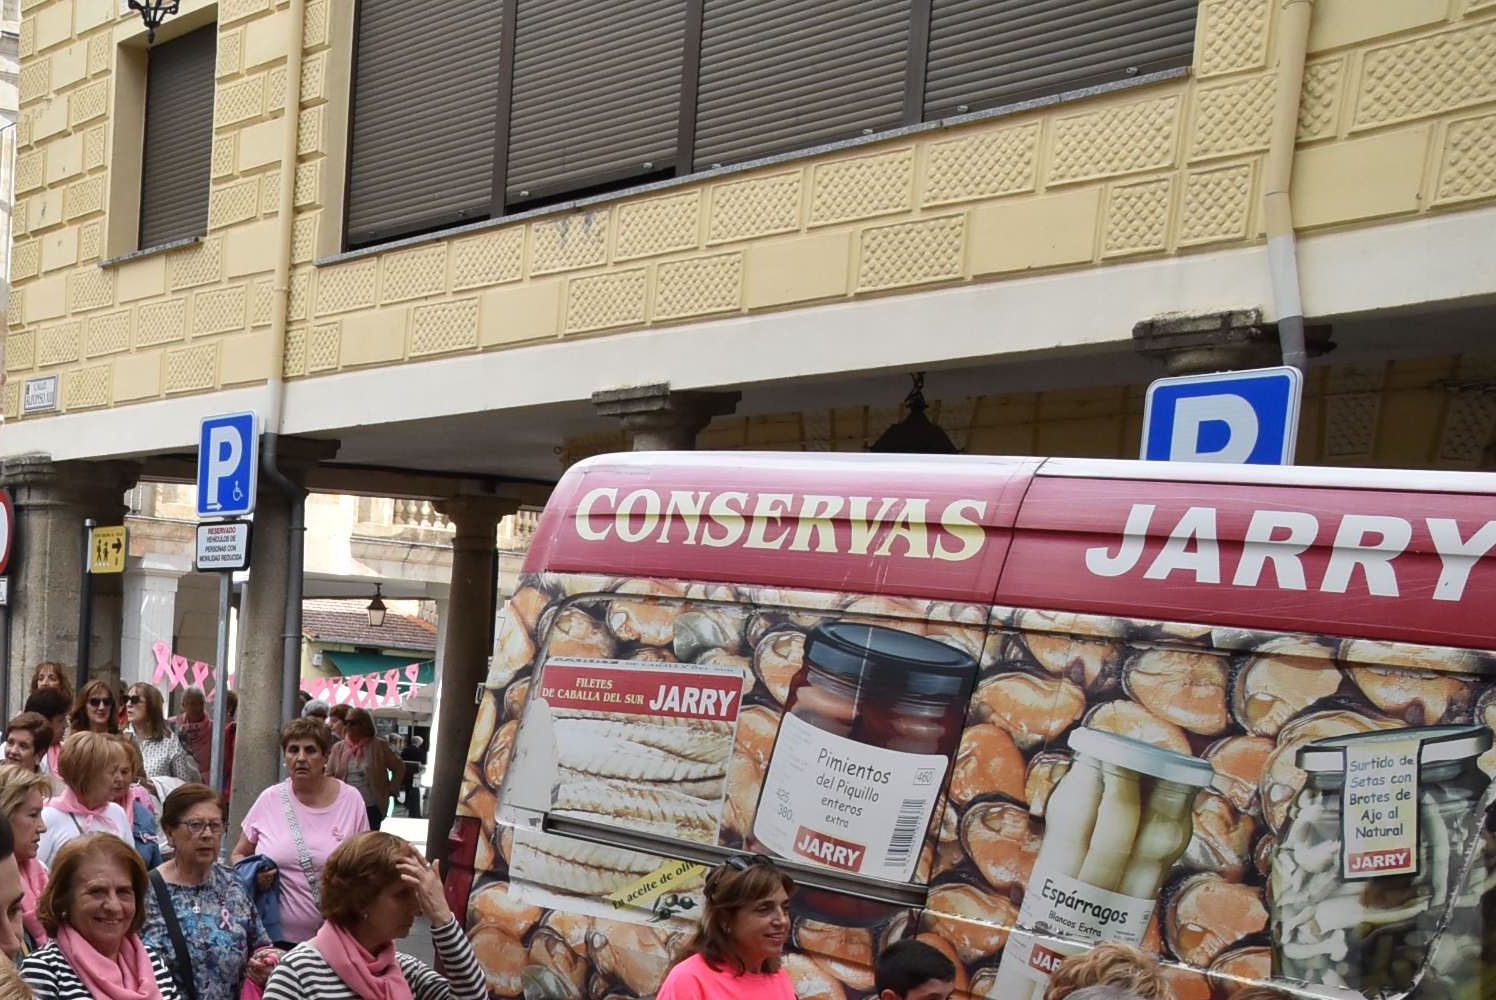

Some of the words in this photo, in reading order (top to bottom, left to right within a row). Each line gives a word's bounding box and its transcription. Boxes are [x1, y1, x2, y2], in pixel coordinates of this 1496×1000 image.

[1170, 393, 1259, 464] P
[207, 425, 242, 504] P
[575, 487, 987, 562] CONSERVAS
[1085, 503, 1496, 602] JARRY
[542, 687, 554, 698] DE
[557, 688, 600, 702] CABALLA
[603, 692, 622, 704] DEL
[625, 694, 644, 705] SUR
[575, 677, 613, 690] FILETES
[649, 684, 737, 717] JARRY
[817, 748, 891, 785] Pimientos
[1350, 755, 1393, 772] Surtido
[1399, 755, 1415, 766] de
[816, 773, 834, 788] del
[837, 779, 880, 803] Piquillo
[1350, 774, 1385, 788] Setas
[1390, 773, 1412, 784] con
[821, 795, 863, 817] enteros
[1349, 791, 1390, 806] Brotes
[1395, 788, 1411, 801] de
[825, 813, 849, 828] extra
[1361, 808, 1382, 824] Ajo
[1388, 806, 1399, 819] al
[1355, 823, 1404, 839] Natural
[798, 834, 860, 867] JARRY
[1352, 852, 1407, 869] JARRY
[627, 880, 658, 904] aceite
[659, 871, 674, 885] de
[1042, 878, 1128, 925] Espárragos
[1048, 910, 1076, 929] Blancos
[1078, 922, 1102, 938] Extra
